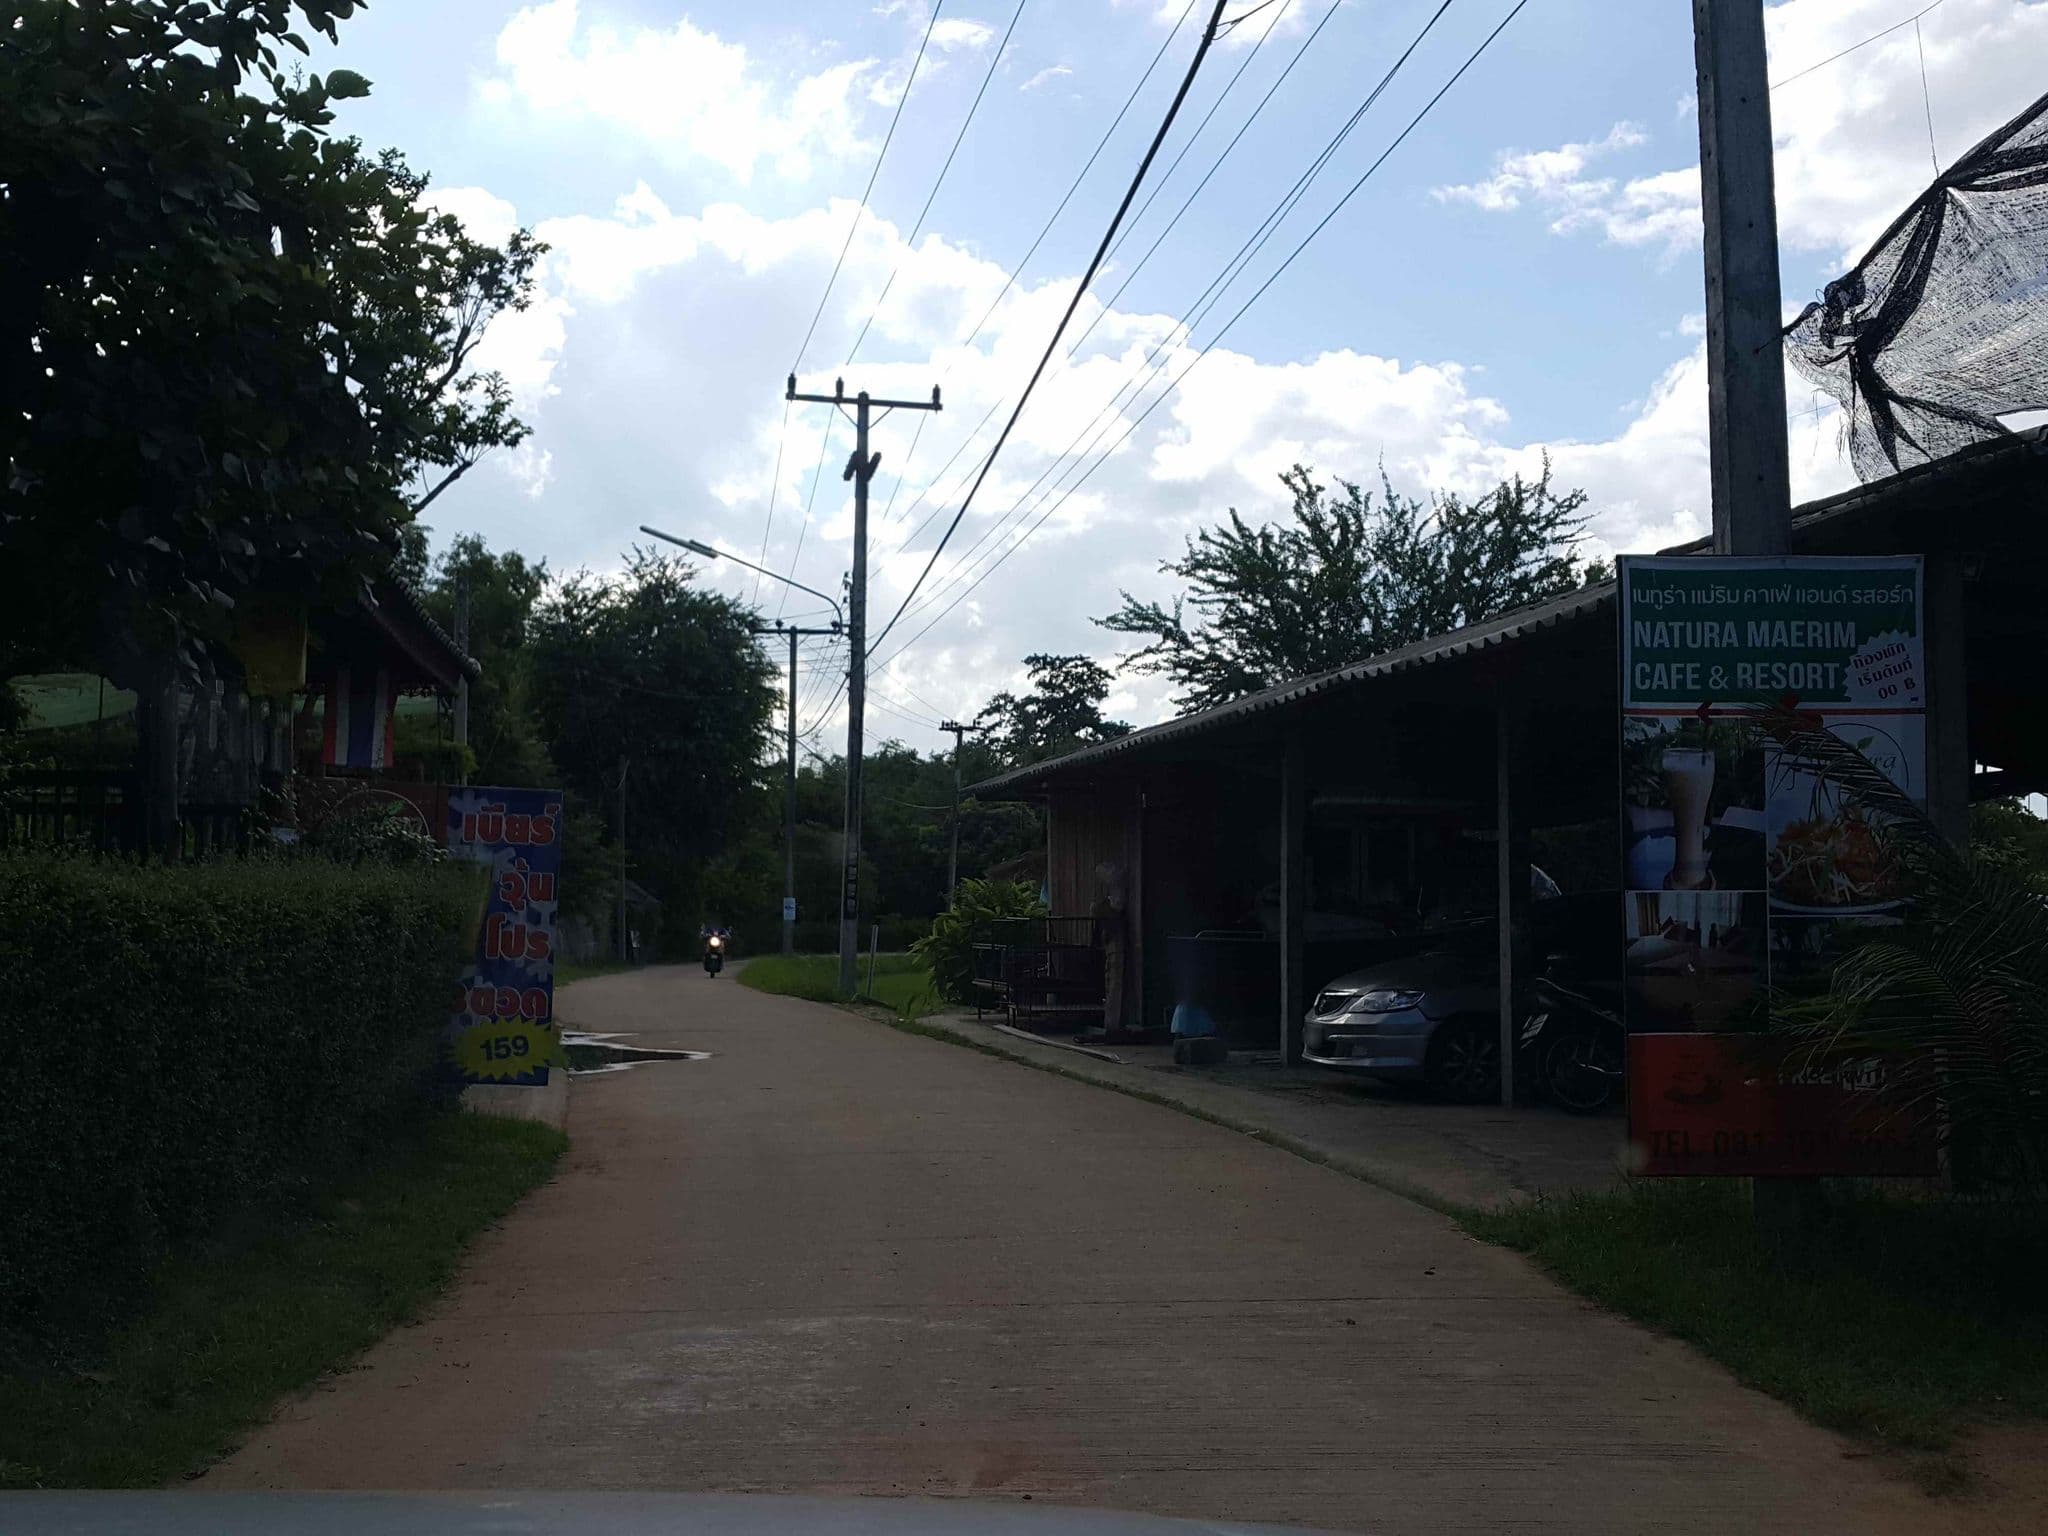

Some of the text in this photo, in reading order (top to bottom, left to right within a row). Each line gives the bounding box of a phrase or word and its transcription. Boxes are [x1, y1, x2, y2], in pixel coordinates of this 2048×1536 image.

[1633, 620, 1857, 649] NATURA MAERIM
[1634, 662, 1841, 690] CAFE & RESORT
[462, 803, 561, 845] เบียร์
[484, 912, 552, 960] โปร
[480, 1035, 530, 1062] 159
